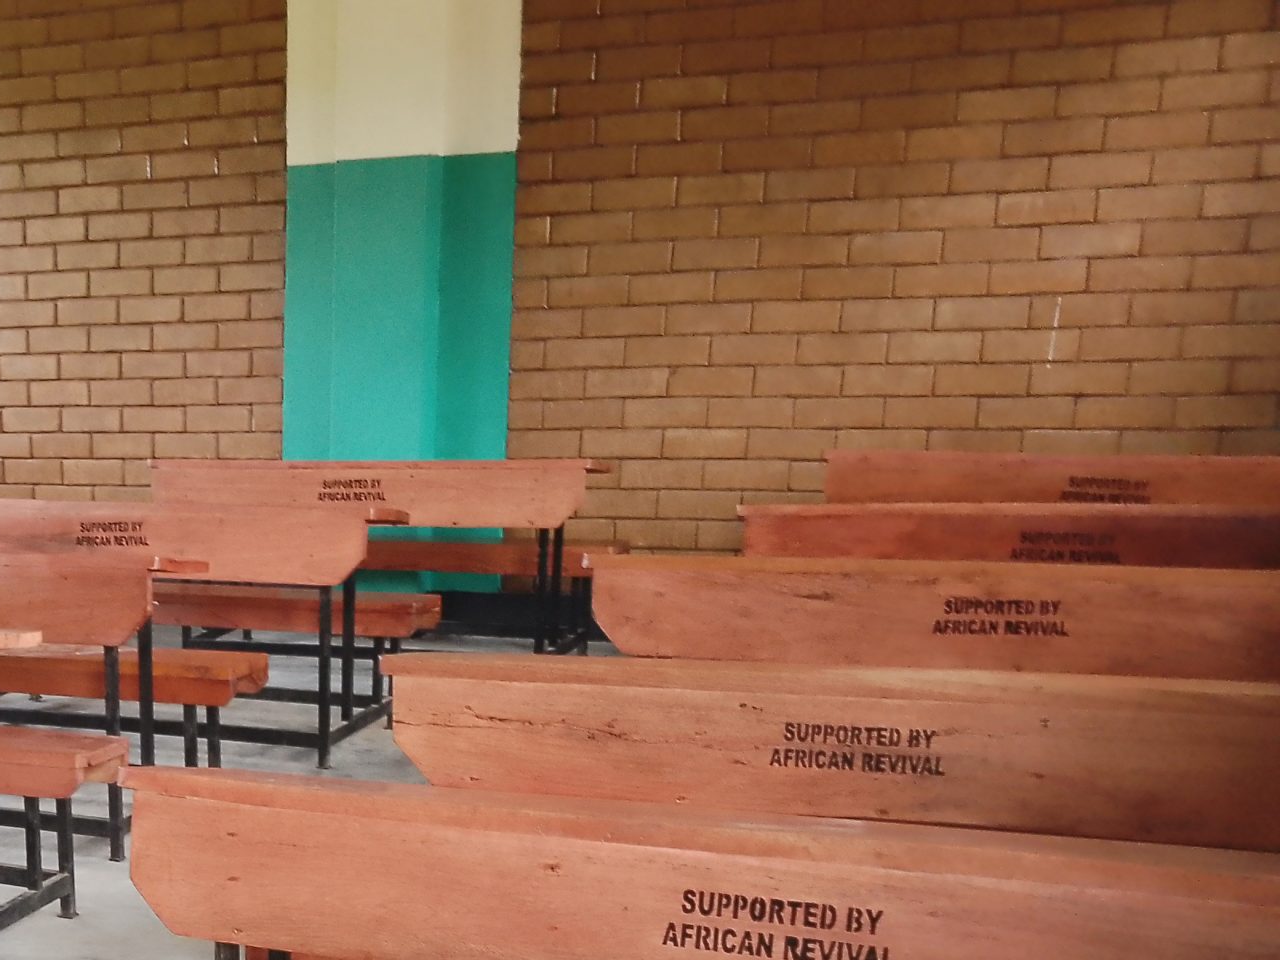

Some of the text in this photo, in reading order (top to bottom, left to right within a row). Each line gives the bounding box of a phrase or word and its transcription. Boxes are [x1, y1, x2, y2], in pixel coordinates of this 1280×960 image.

[80, 521, 129, 532] SUPPORTED
[76, 536, 111, 546] AFRICAN
[943, 597, 1061, 615] SUPPORTED BY
[932, 619, 1069, 637] AFRICAN REVIVAL
[784, 722, 939, 749] SUPPORTED BY
[769, 748, 946, 777] AFRICAN REVIVAL
[681, 889, 884, 935] SUPPORTED BY
[662, 921, 774, 958] AFRICAN
